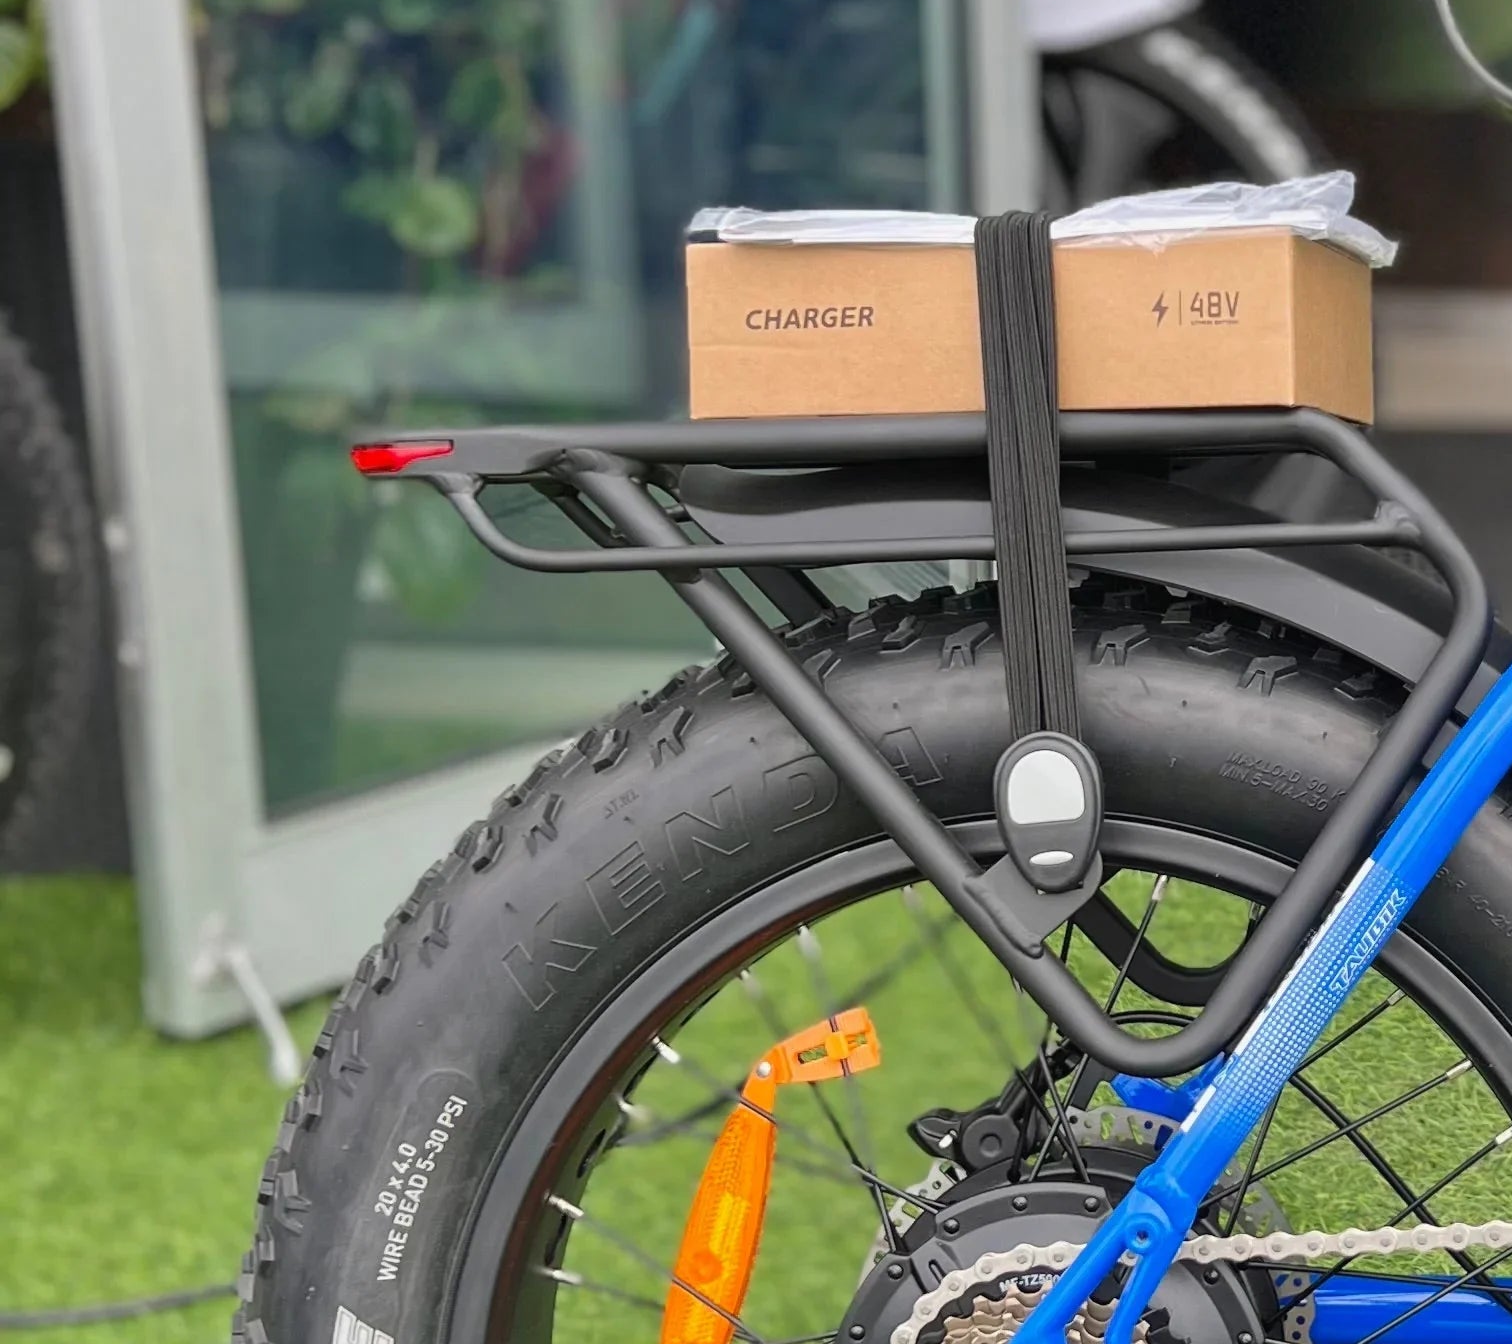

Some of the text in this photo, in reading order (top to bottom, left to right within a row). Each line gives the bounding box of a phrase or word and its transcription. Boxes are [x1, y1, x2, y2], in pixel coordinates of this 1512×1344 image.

[745, 306, 874, 330] CHARGER
[1190, 291, 1239, 317] 48V
[374, 1190, 397, 1217] 20
[392, 1142, 417, 1174] 4.0
[377, 1095, 468, 1281] WIRE BEAD 5-30 PSI
